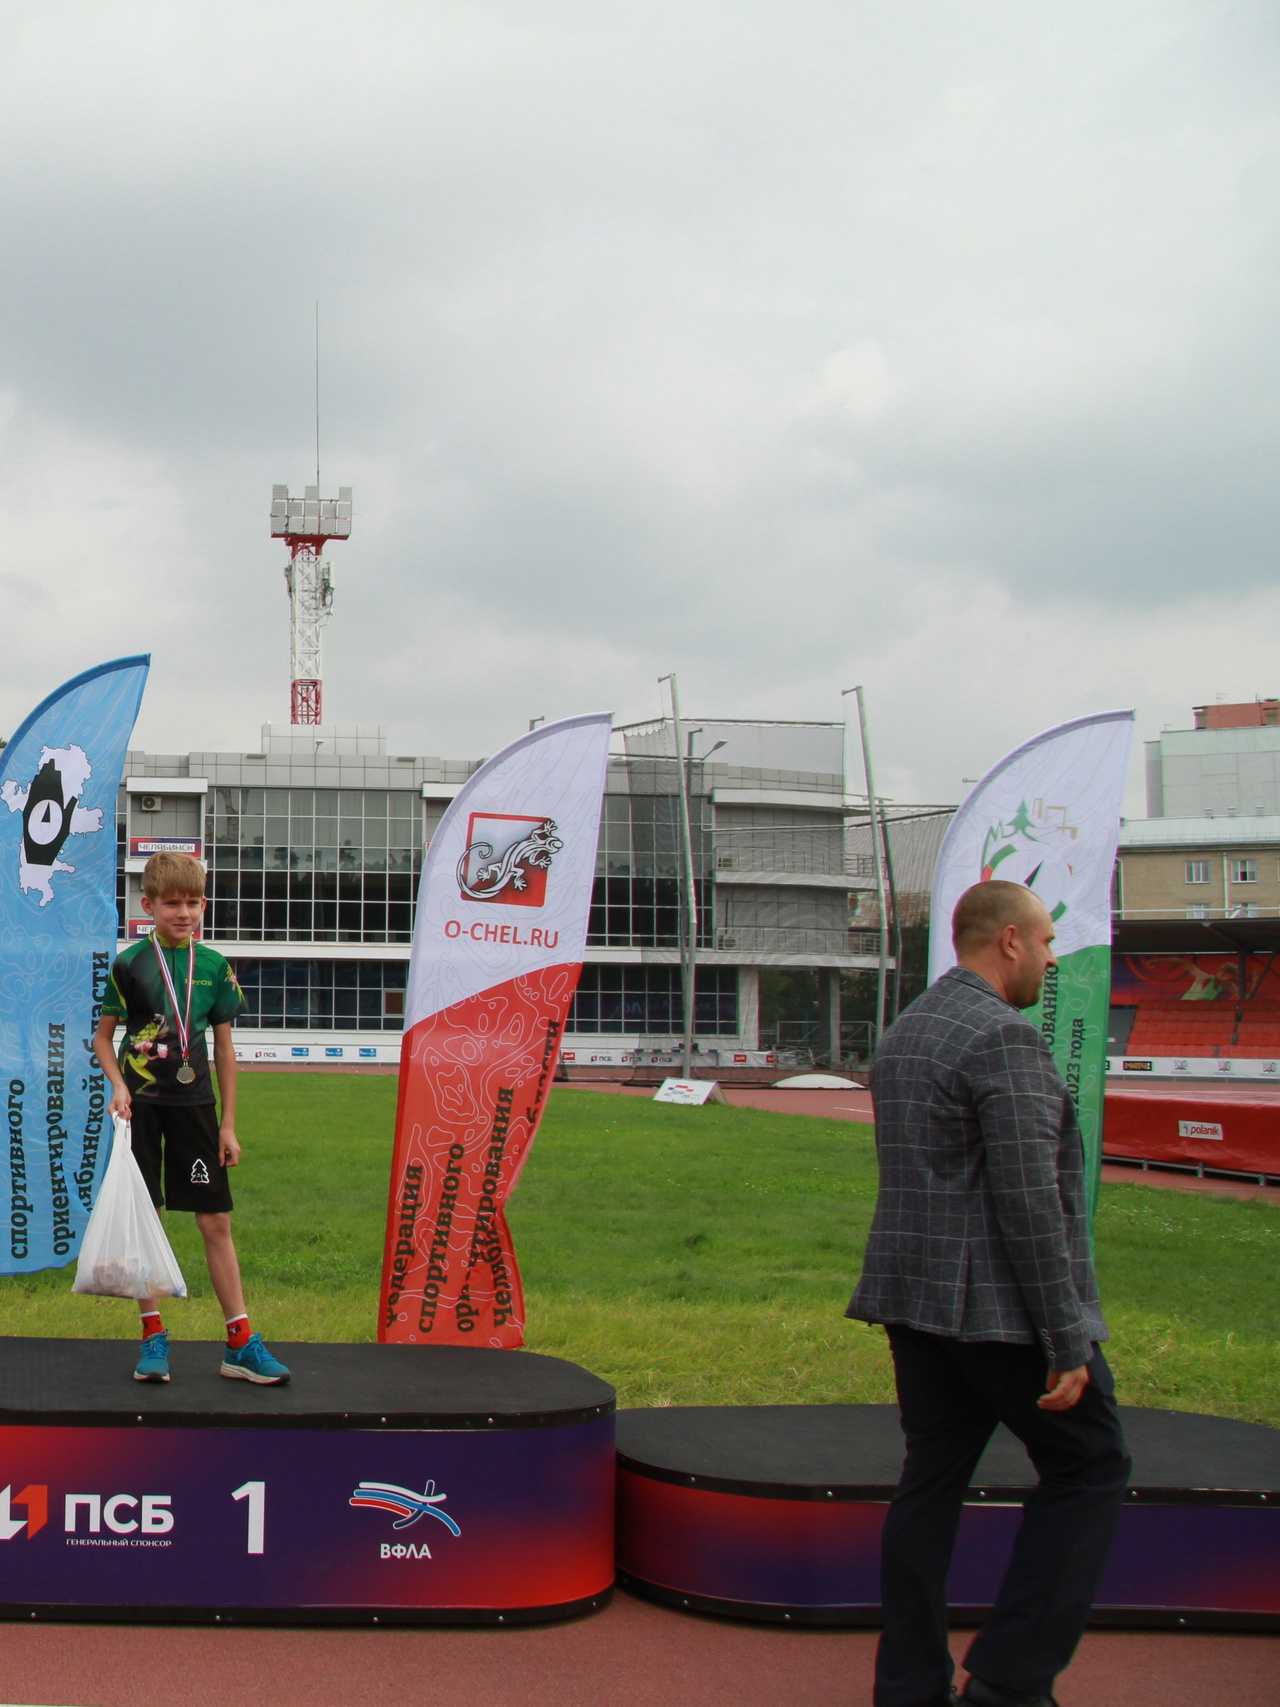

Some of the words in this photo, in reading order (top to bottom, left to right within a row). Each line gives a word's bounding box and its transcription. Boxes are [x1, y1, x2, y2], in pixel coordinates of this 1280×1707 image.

[139, 844, 194, 852] ЧЕЛЯБИНСК
[444, 919, 559, 949] O-CHEL.RU
[1070, 1017, 1087, 1060] года
[45, 1022, 76, 1256] ориентирования
[73, 1073, 106, 1214] ябинской
[1190, 1124, 1220, 1136] polanik
[7, 1078, 34, 1260] спортивного
[456, 1086, 515, 1333] оритирования
[419, 1143, 465, 1333] спортивного
[64, 1493, 175, 1534] ПСБ
[230, 1480, 266, 1555] 1
[66, 1538, 128, 1547] ГЕНЕРАЛЬНЫЙ
[130, 1539, 172, 1548] СПОНСОР
[379, 1543, 432, 1560] ВФЛА
